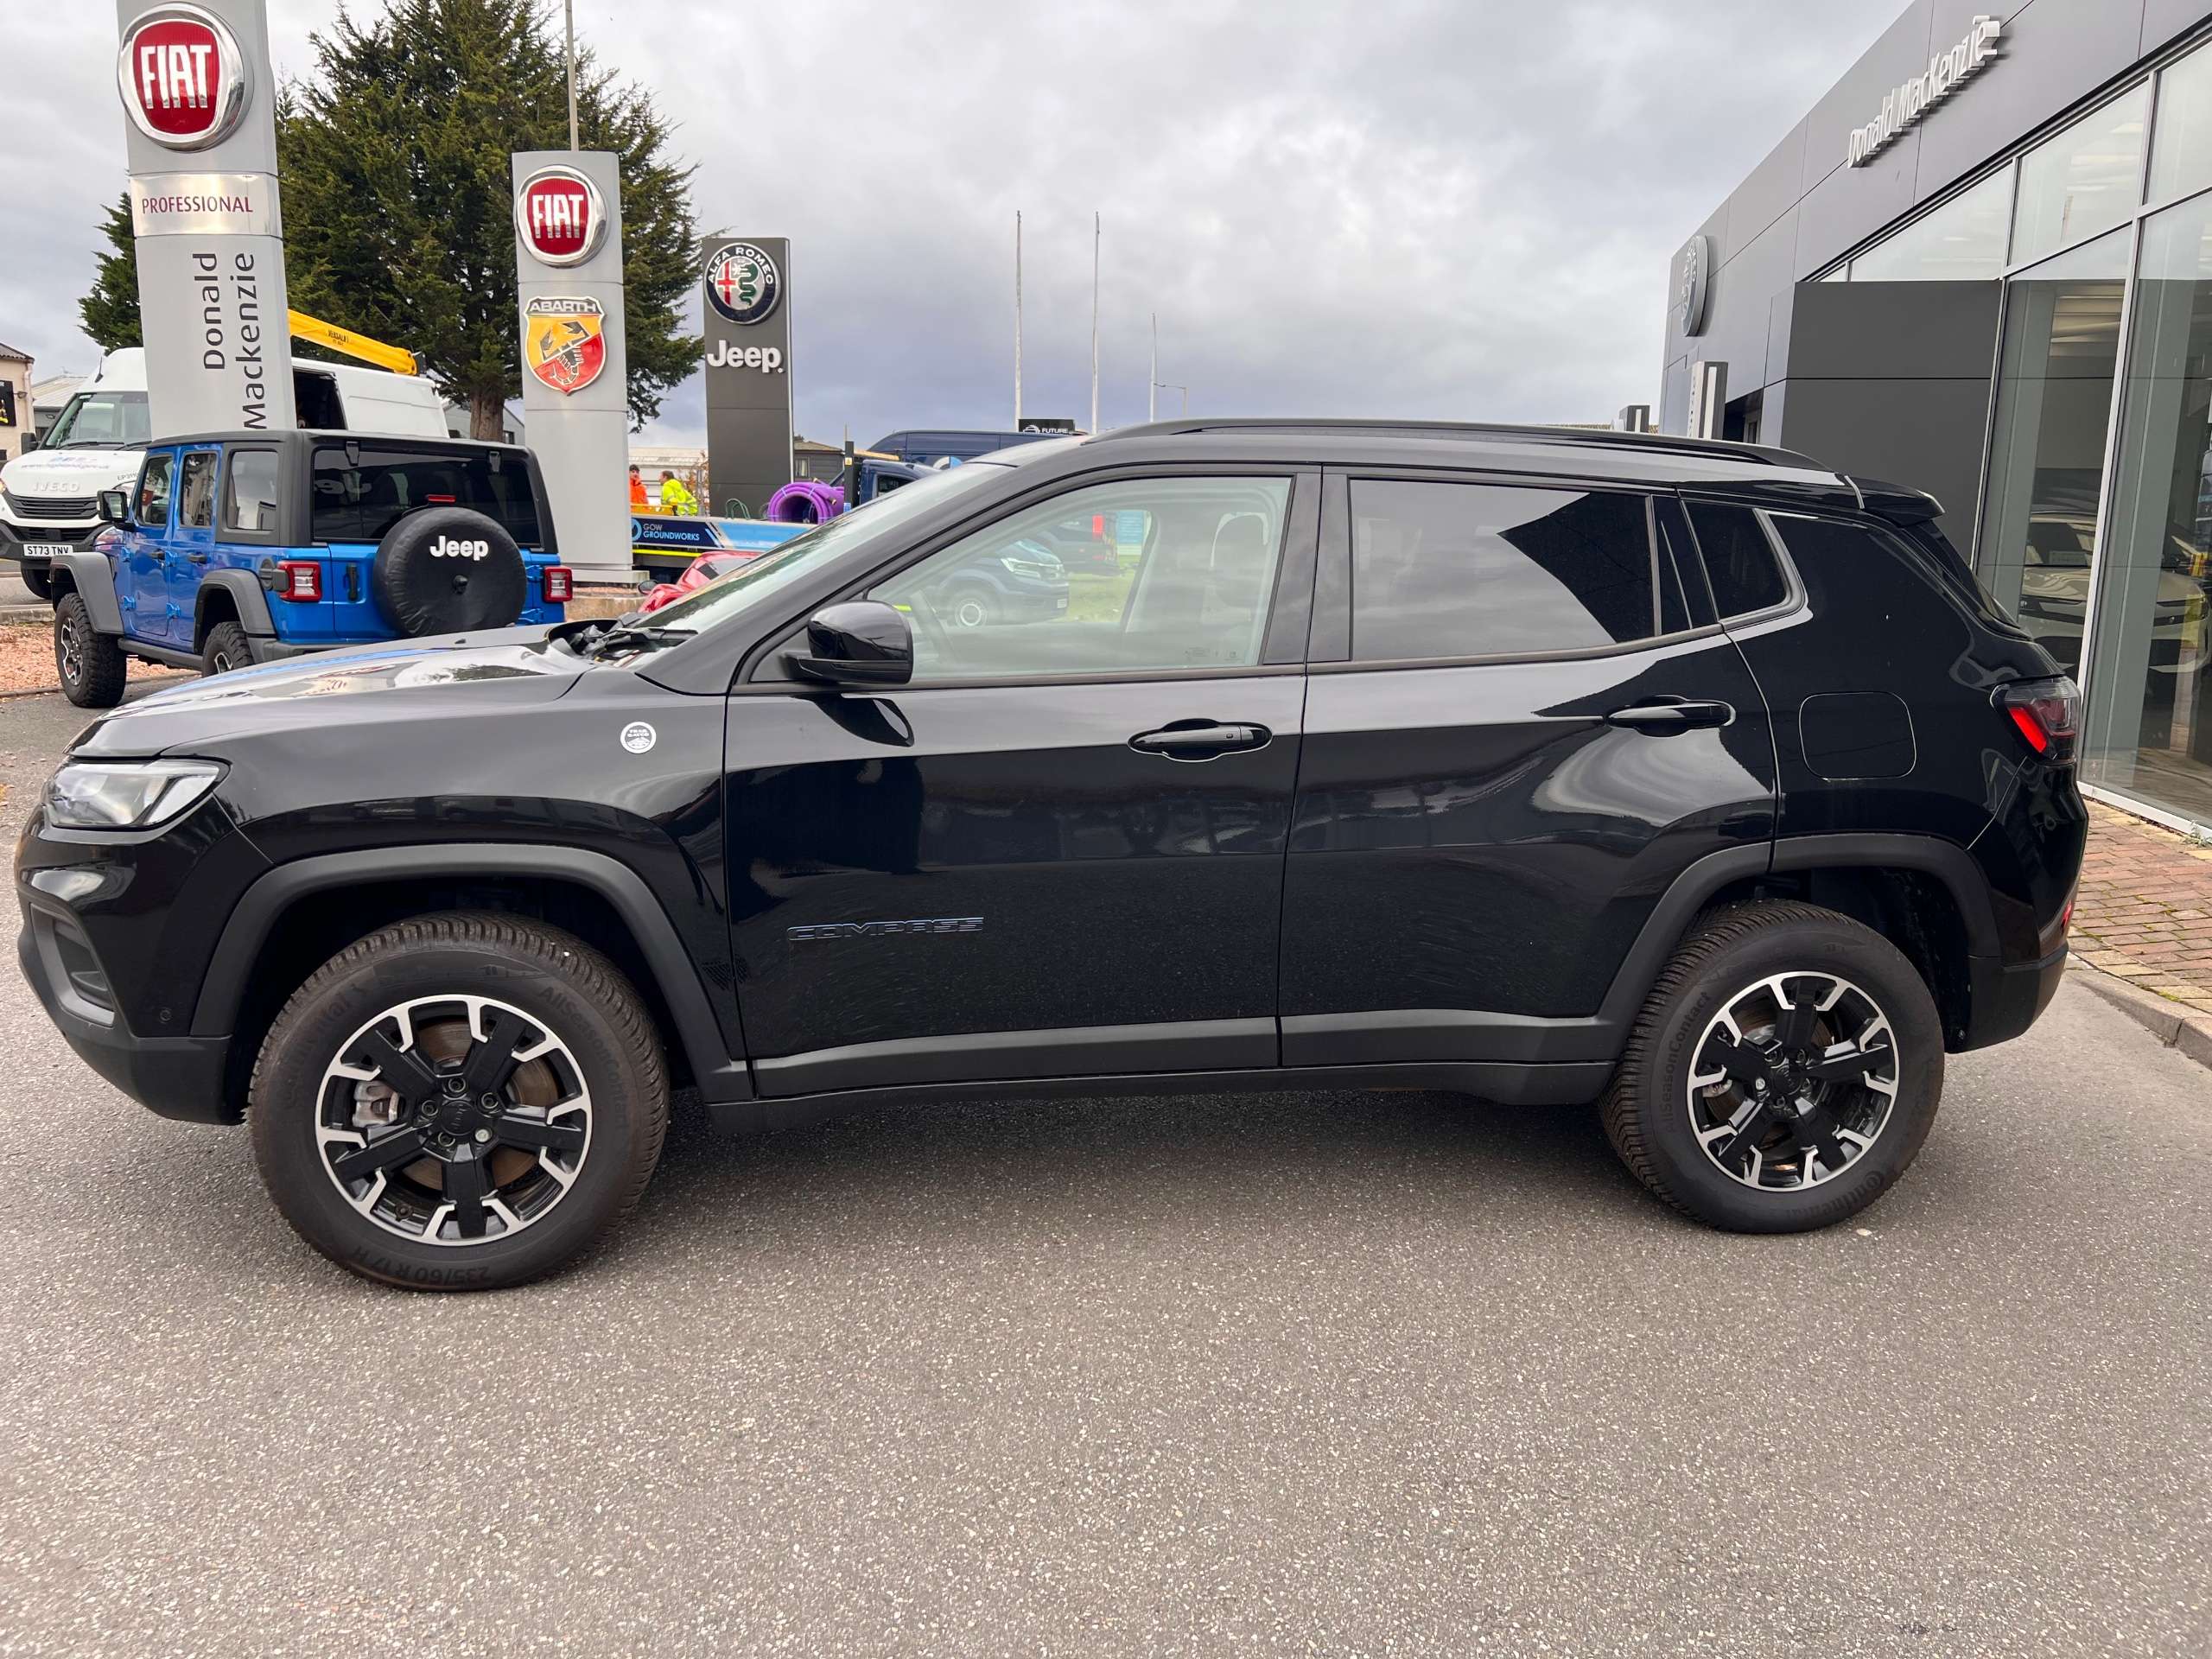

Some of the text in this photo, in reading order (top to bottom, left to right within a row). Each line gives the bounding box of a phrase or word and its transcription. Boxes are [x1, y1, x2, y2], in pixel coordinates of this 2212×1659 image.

[140, 44, 213, 110] FIAT
[142, 196, 253, 214] PROFESSIONAL
[531, 194, 584, 239] FIAT
[708, 246, 774, 285] ALFA ROMEO
[192, 253, 226, 370] Donald
[529, 300, 596, 313] ABARTH
[230, 252, 268, 429] Mackenzie
[32, 480, 82, 493] IVECO
[642, 523, 664, 531] GOW
[642, 530, 701, 542] GROUNDWORKS
[27, 545, 69, 555] ST73 TNV
[429, 535, 489, 562] Jeep
